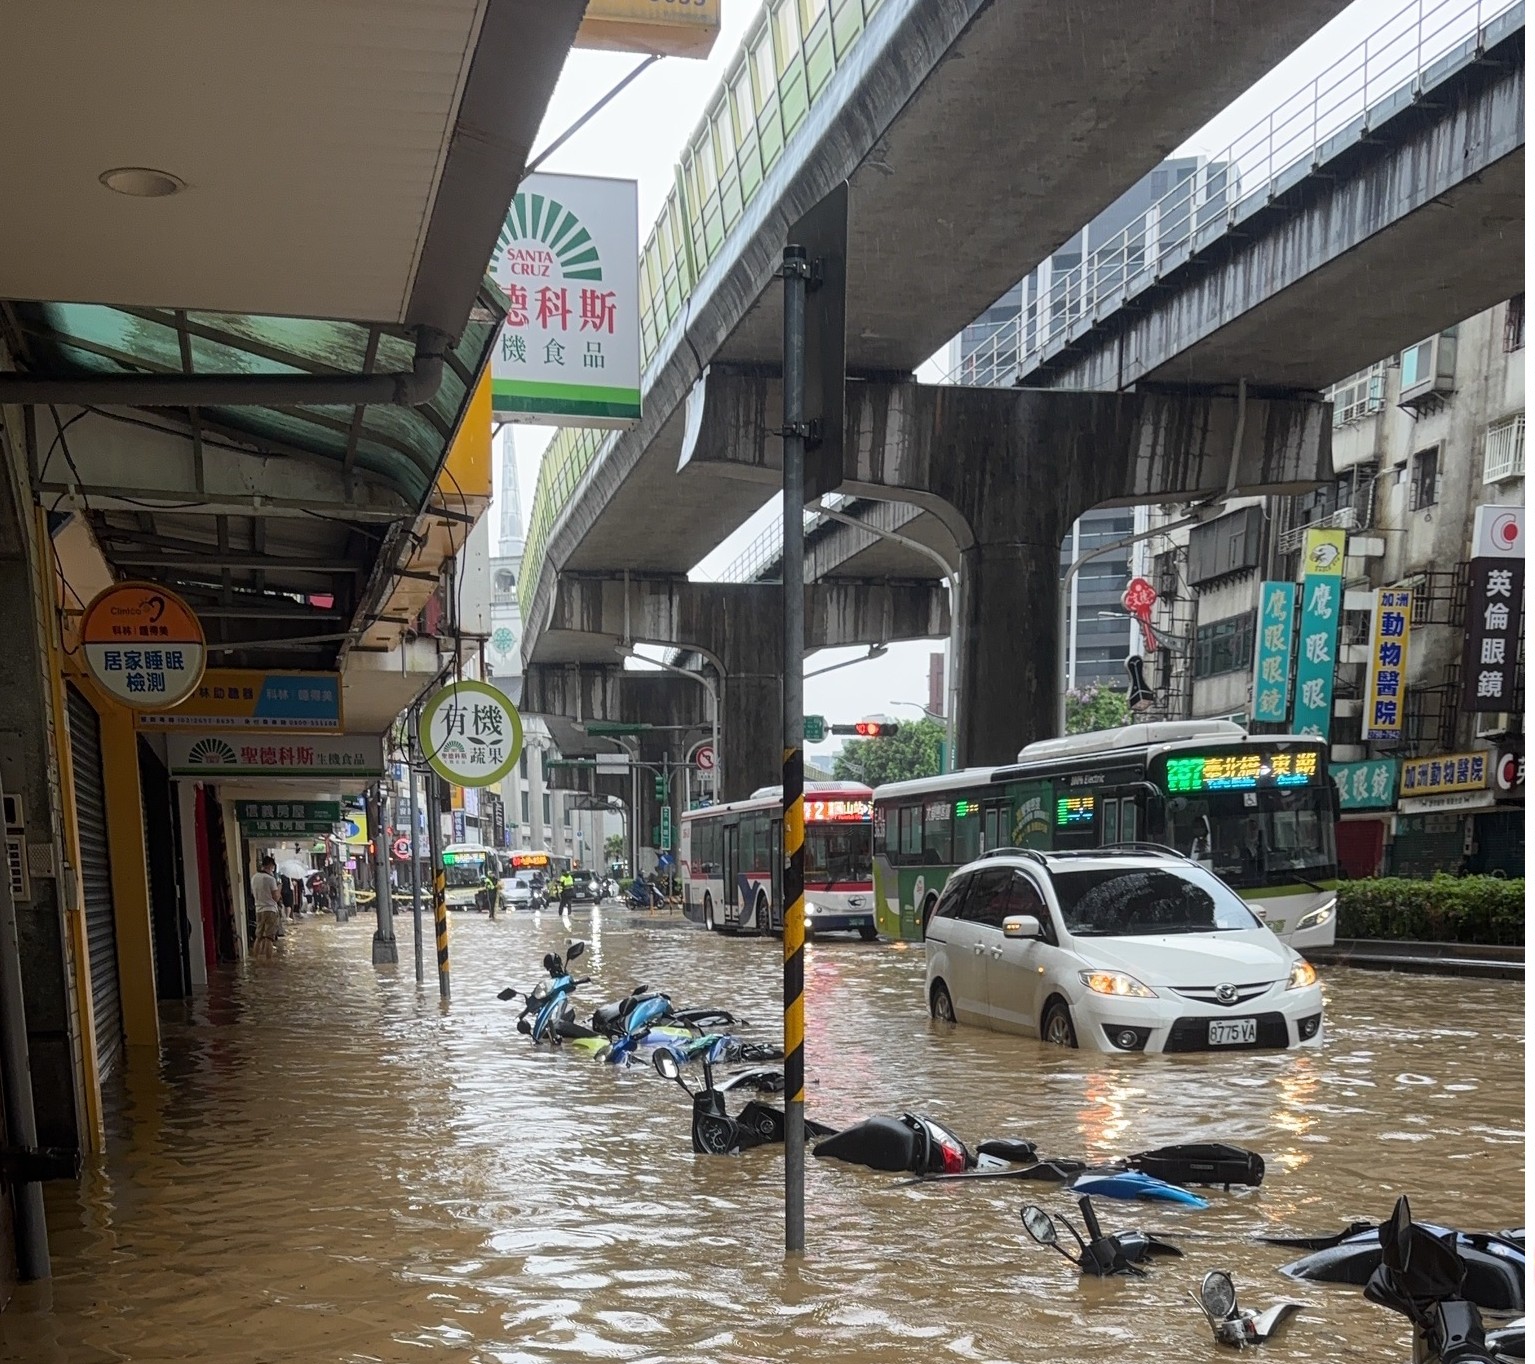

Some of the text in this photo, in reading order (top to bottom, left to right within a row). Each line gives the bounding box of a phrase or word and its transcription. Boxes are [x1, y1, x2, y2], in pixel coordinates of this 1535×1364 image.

[507, 248, 554, 264] SANTA
[511, 262, 551, 278] CRUZ
[1381, 592, 1409, 607] 加洲
[1476, 569, 1513, 698] 英倫眼鏡
[104, 650, 184, 670] 居家睡眠
[1258, 588, 1287, 716] 鷹眼眼鏡
[1375, 611, 1404, 726] 動物醫院
[126, 672, 166, 692] 檢測
[440, 703, 503, 736] 有機
[240, 746, 365, 766] 聖德科斯 生機食品
[469, 747, 503, 765] 蔬果
[1404, 756, 1483, 789] 加洲動物醫院
